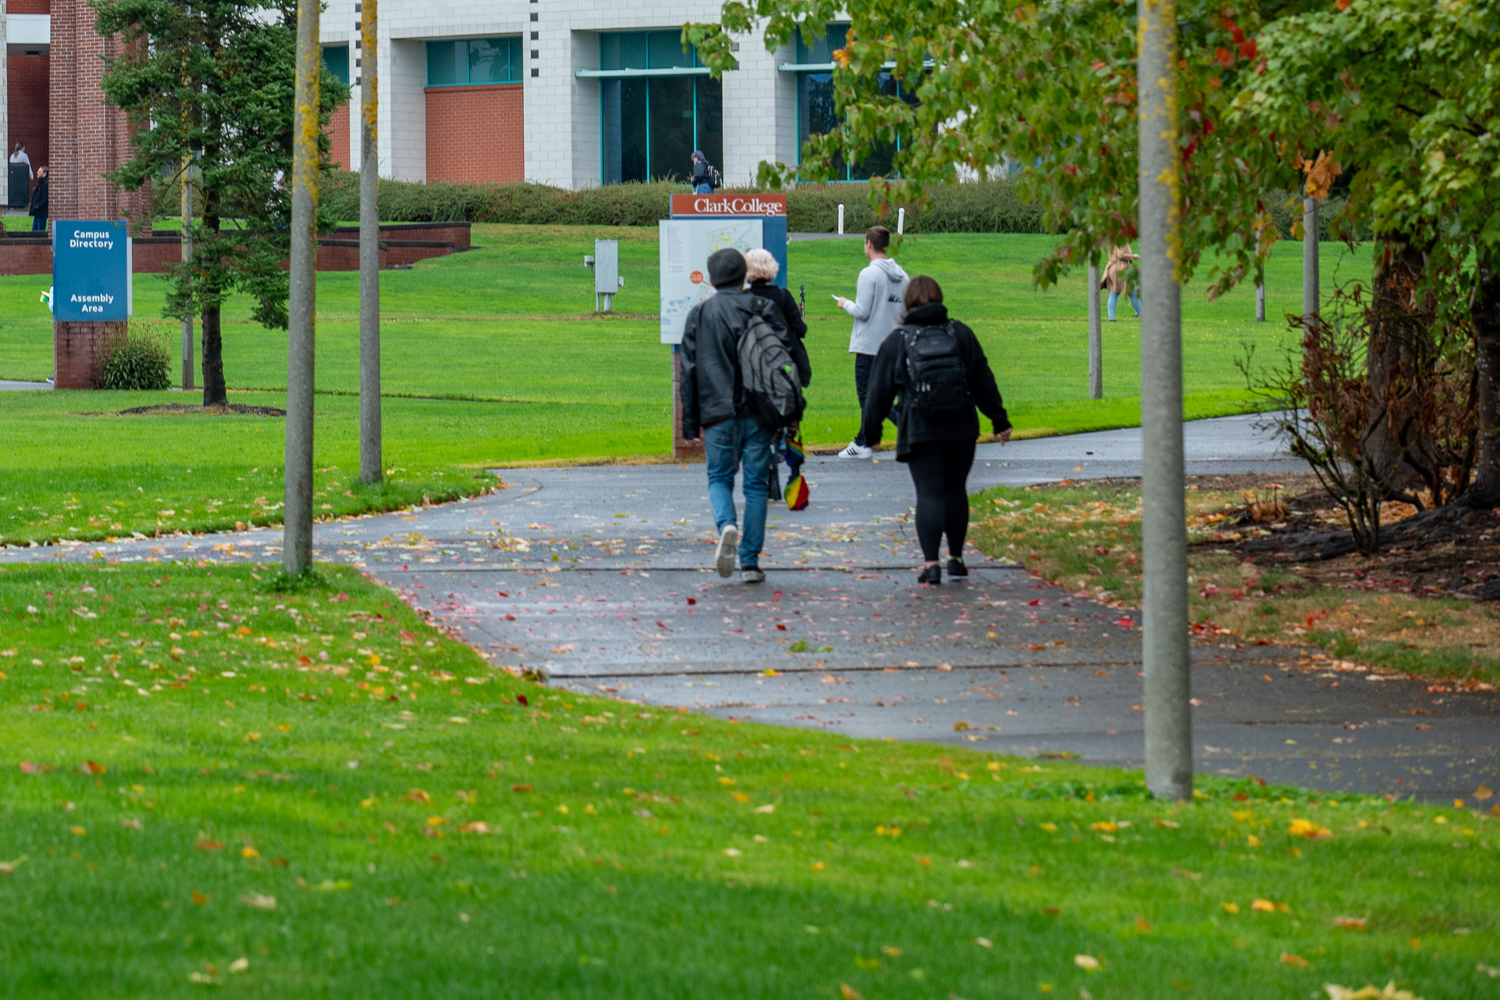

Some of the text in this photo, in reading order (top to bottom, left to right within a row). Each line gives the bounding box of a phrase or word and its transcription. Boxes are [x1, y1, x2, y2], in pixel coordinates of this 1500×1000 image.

[74, 230, 109, 240] Campus
[70, 239, 114, 250] Directory
[70, 293, 114, 305] Assembly
[81, 304, 104, 313] Area
